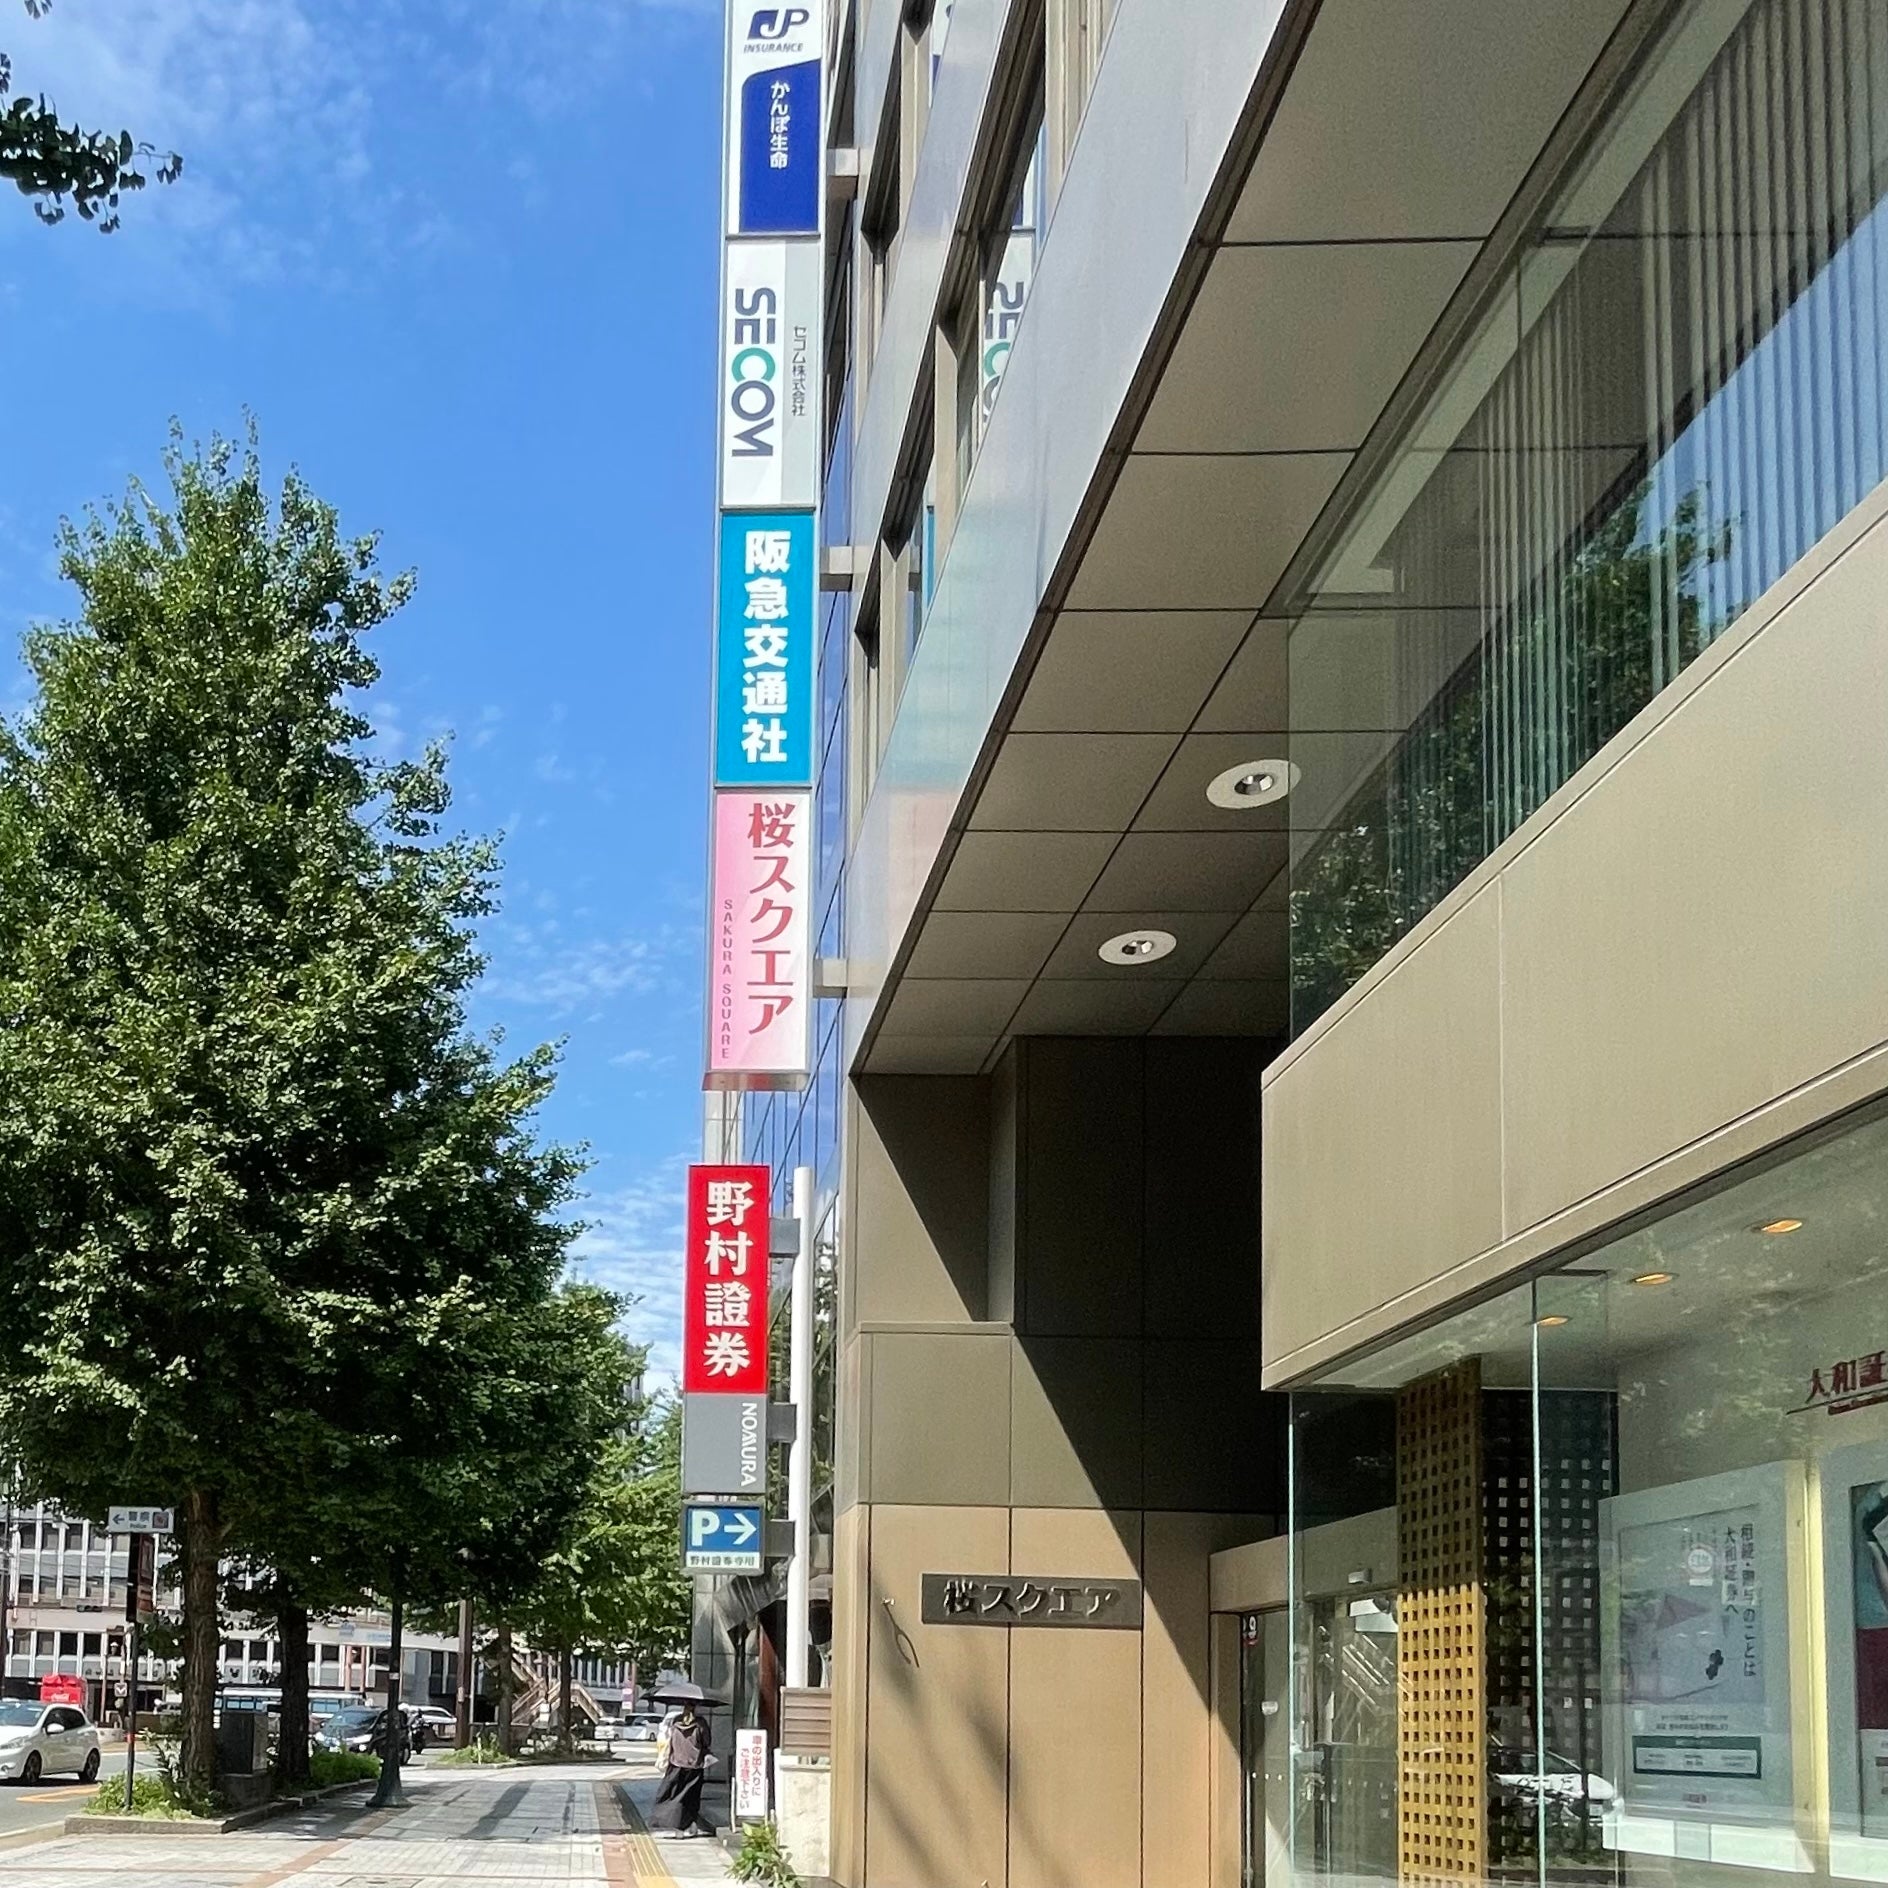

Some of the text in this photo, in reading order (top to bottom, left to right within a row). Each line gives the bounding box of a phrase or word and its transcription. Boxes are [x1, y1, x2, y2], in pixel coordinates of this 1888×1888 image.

[743, 43, 804, 54] INSURANCE
[747, 8, 810, 40] JP
[769, 80, 791, 170] かんぽ生命
[731, 287, 777, 458] SECOM
[791, 326, 808, 417] セコム株式会社
[741, 530, 792, 764] 阪急交通社
[747, 801, 796, 1036] 桜スクエア
[720, 899, 735, 1060] SAKURA SQUARE
[703, 1180, 755, 1378] 野村證券
[740, 1402, 758, 1488] NOMURA
[692, 1510, 720, 1547] P
[942, 1578, 1122, 1617] 桜スクエア
[752, 1735, 763, 1797] 車の出入りに
